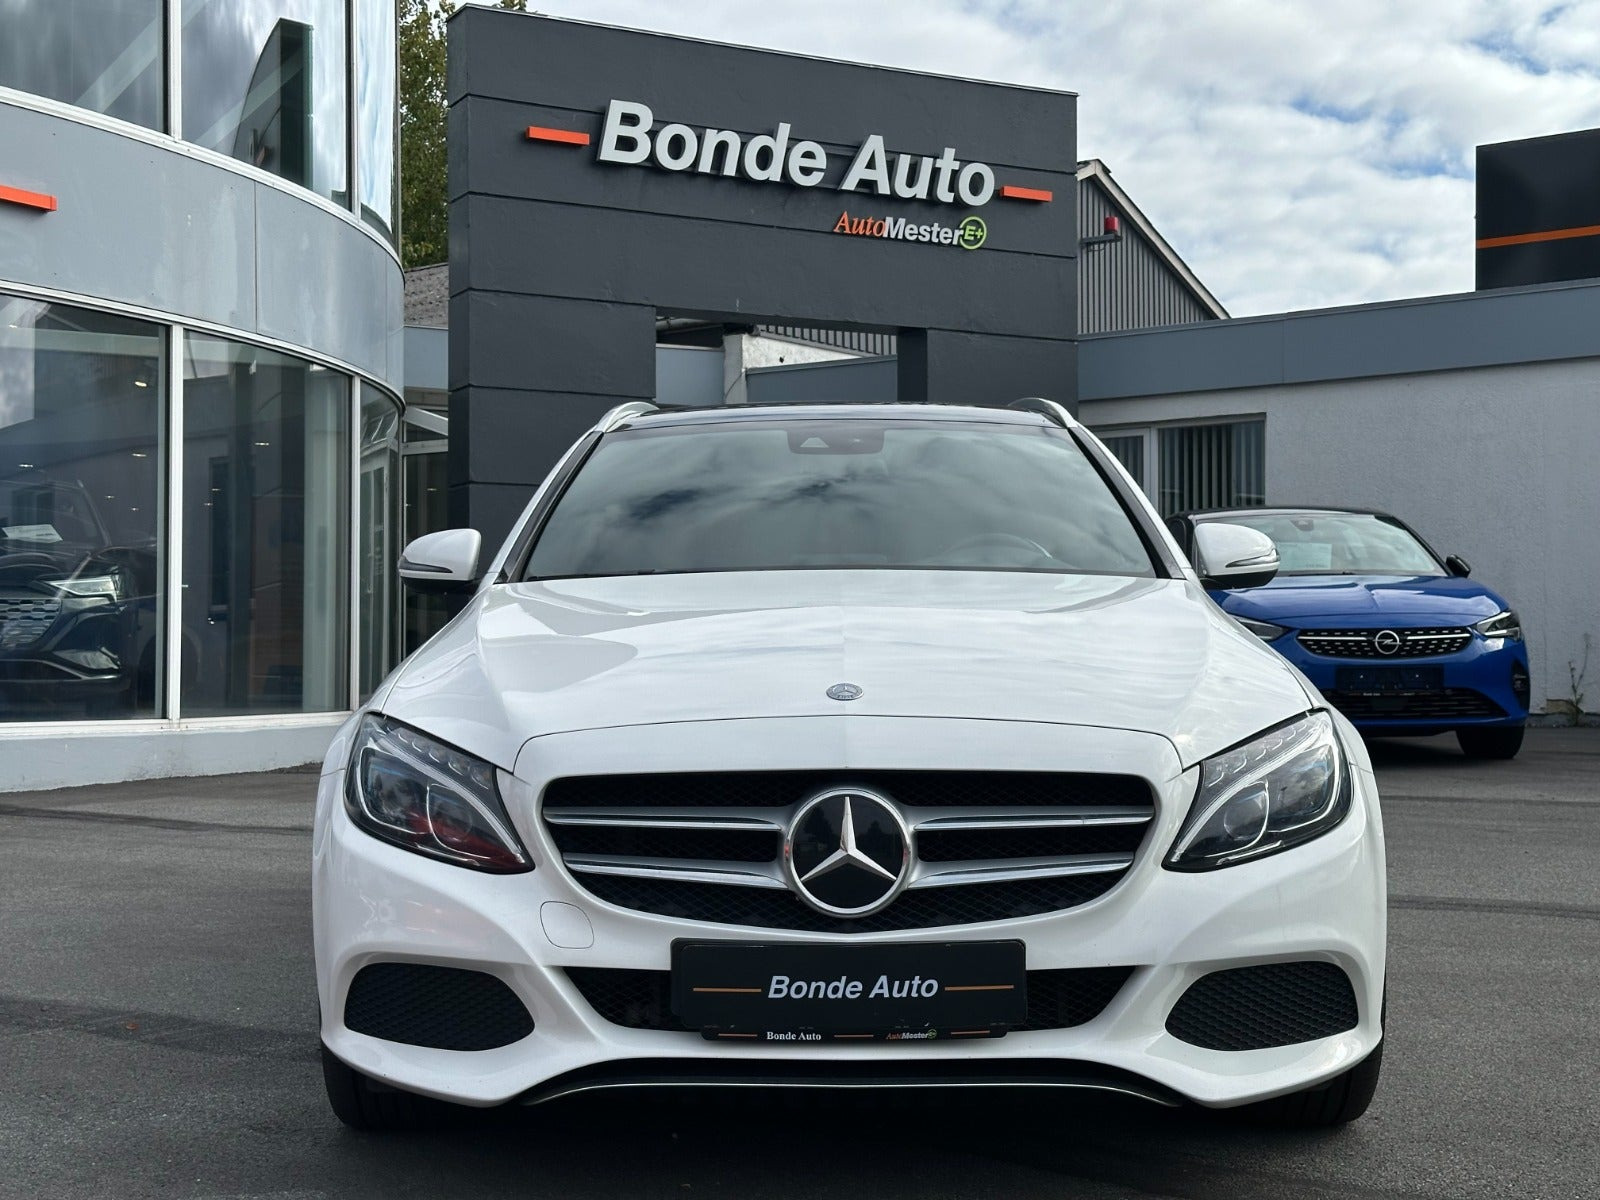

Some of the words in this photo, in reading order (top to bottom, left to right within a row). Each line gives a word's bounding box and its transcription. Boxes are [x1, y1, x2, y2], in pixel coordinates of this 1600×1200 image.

[598, 99, 827, 187] Bonde
[839, 134, 995, 206] Auto
[768, 975, 863, 999] Bonde
[869, 975, 939, 998] Auto
[767, 1031, 797, 1040] Bonde
[798, 1032, 822, 1041] Auto
